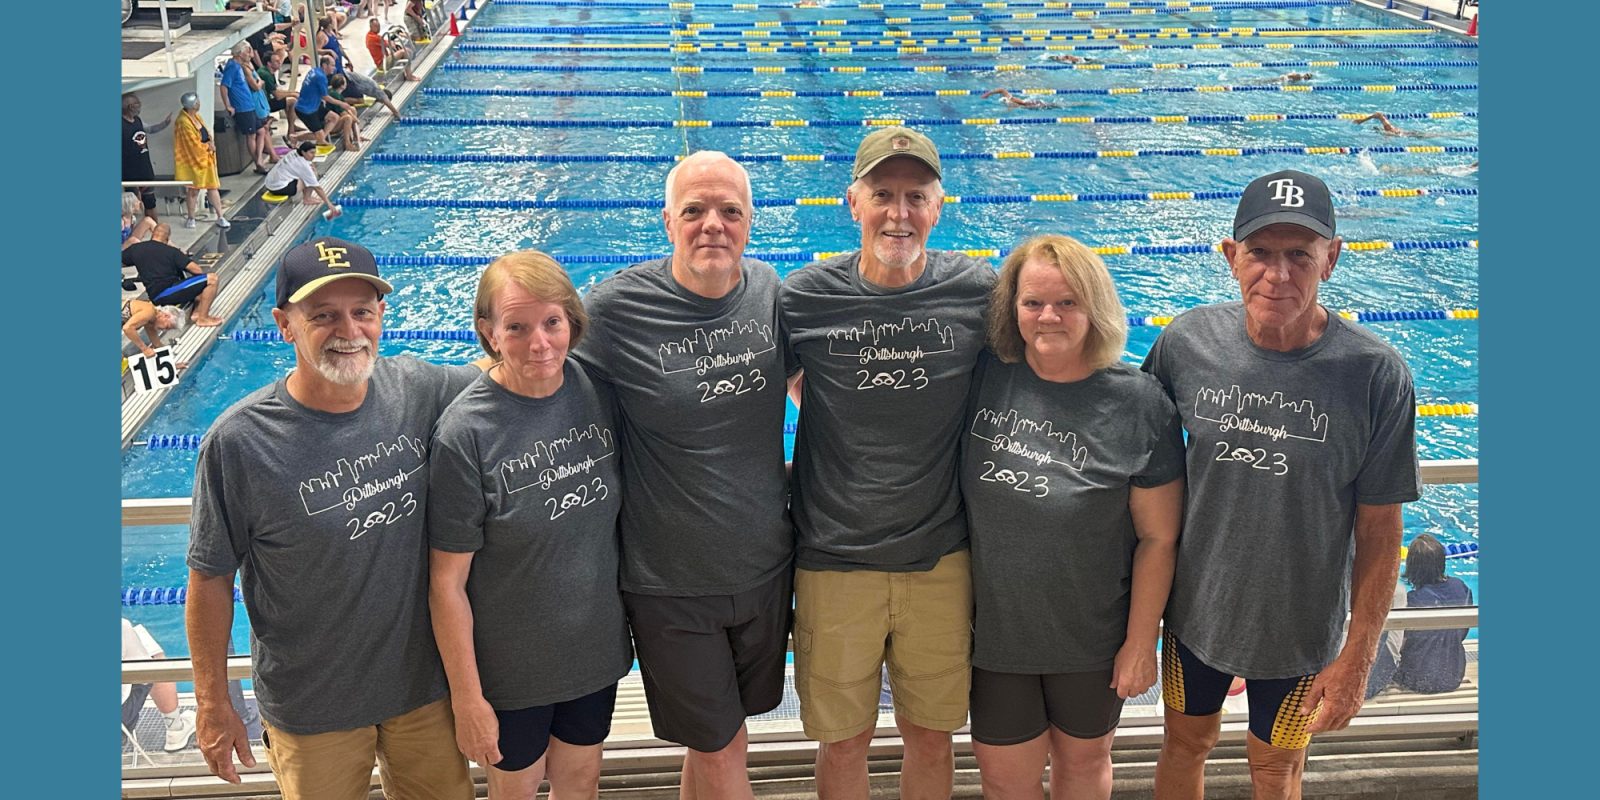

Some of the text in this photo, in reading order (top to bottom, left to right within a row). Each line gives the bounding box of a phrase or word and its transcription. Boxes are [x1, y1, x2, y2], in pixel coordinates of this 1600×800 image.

[1267, 178, 1305, 208] TB
[315, 242, 351, 268] LE
[133, 349, 175, 390] 15
[695, 350, 756, 376] Pittsburgh
[859, 346, 924, 364] Pittsburgh
[1219, 413, 1289, 440] Pittsburgh
[991, 433, 1053, 466] Pittsburgh
[538, 455, 596, 490] Pittsburgh
[343, 472, 409, 510] Pittsburgh
